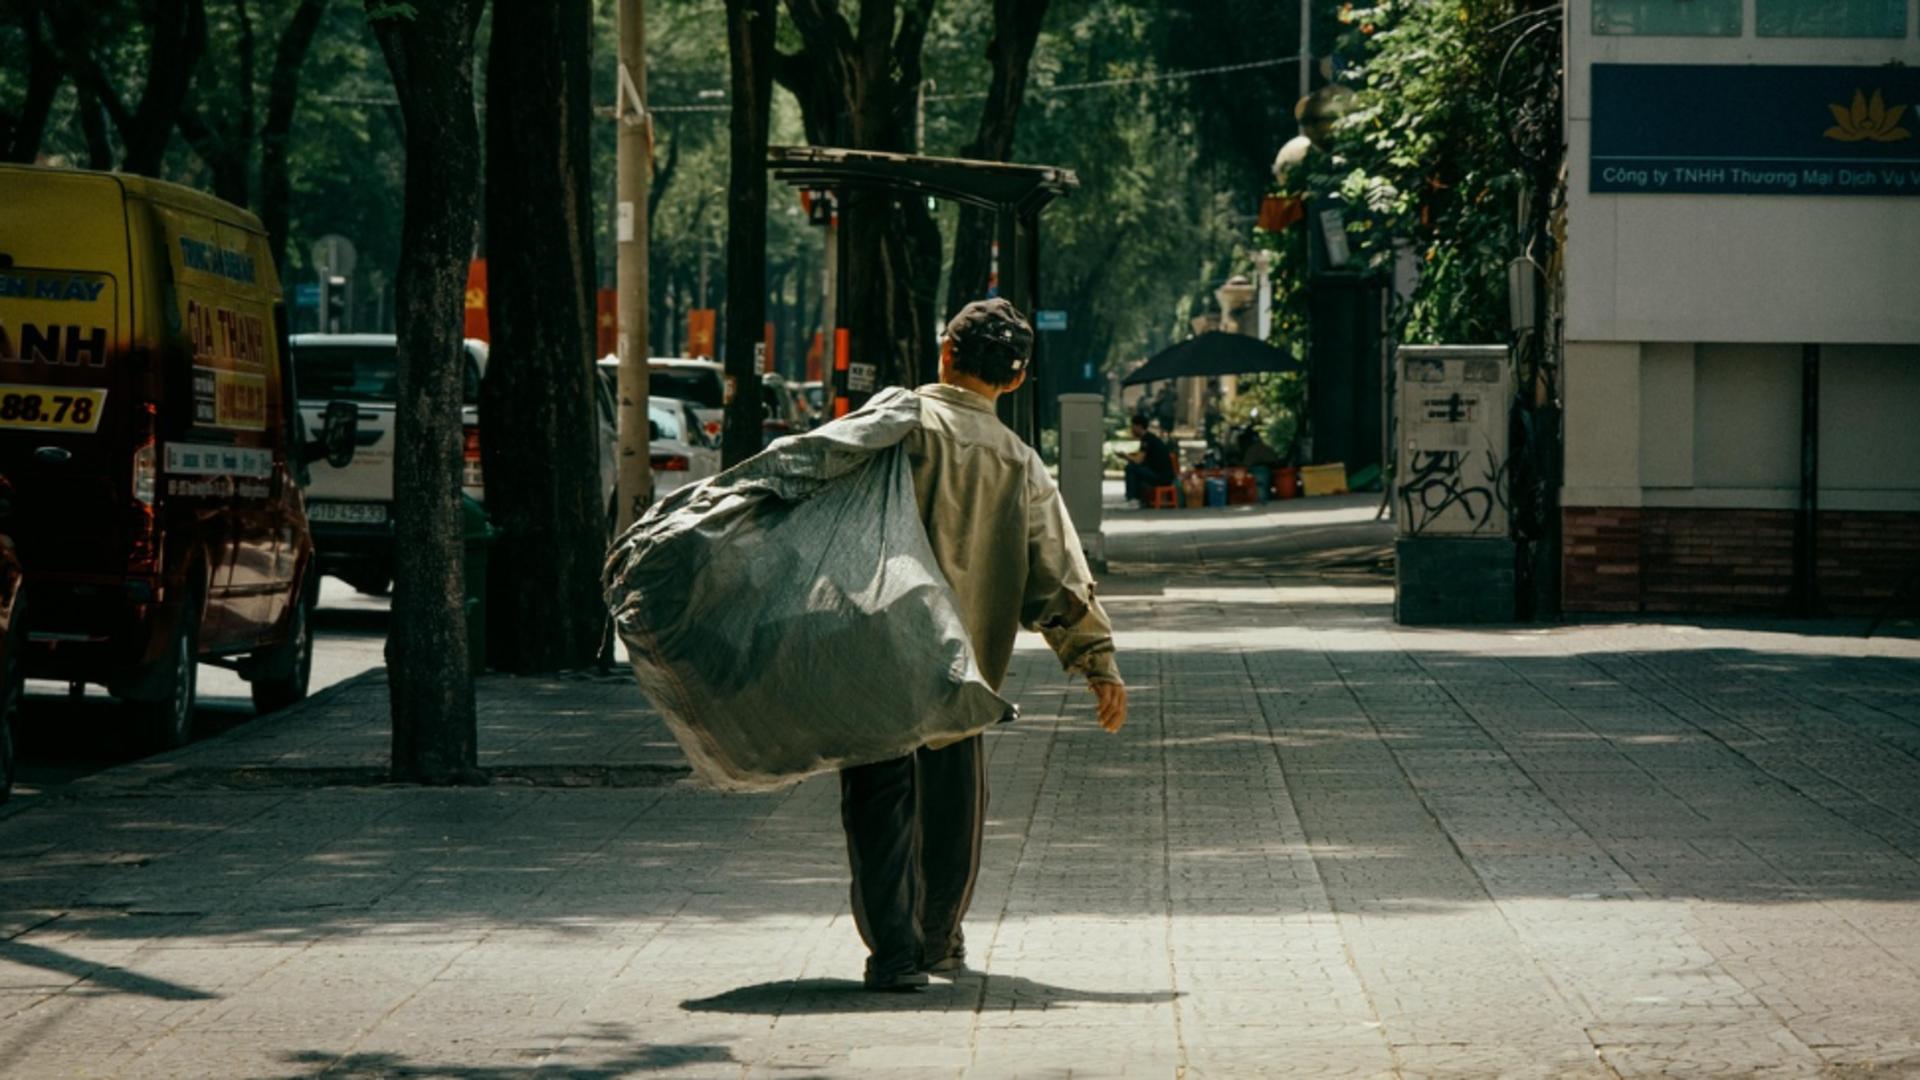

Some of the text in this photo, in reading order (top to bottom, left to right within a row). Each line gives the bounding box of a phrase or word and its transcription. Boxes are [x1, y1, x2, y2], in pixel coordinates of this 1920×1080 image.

[1602, 167, 1648, 186] Công
[1653, 168, 1668, 187] ty
[1673, 168, 1725, 183] TNHH
[1731, 167, 1797, 188] Thương
